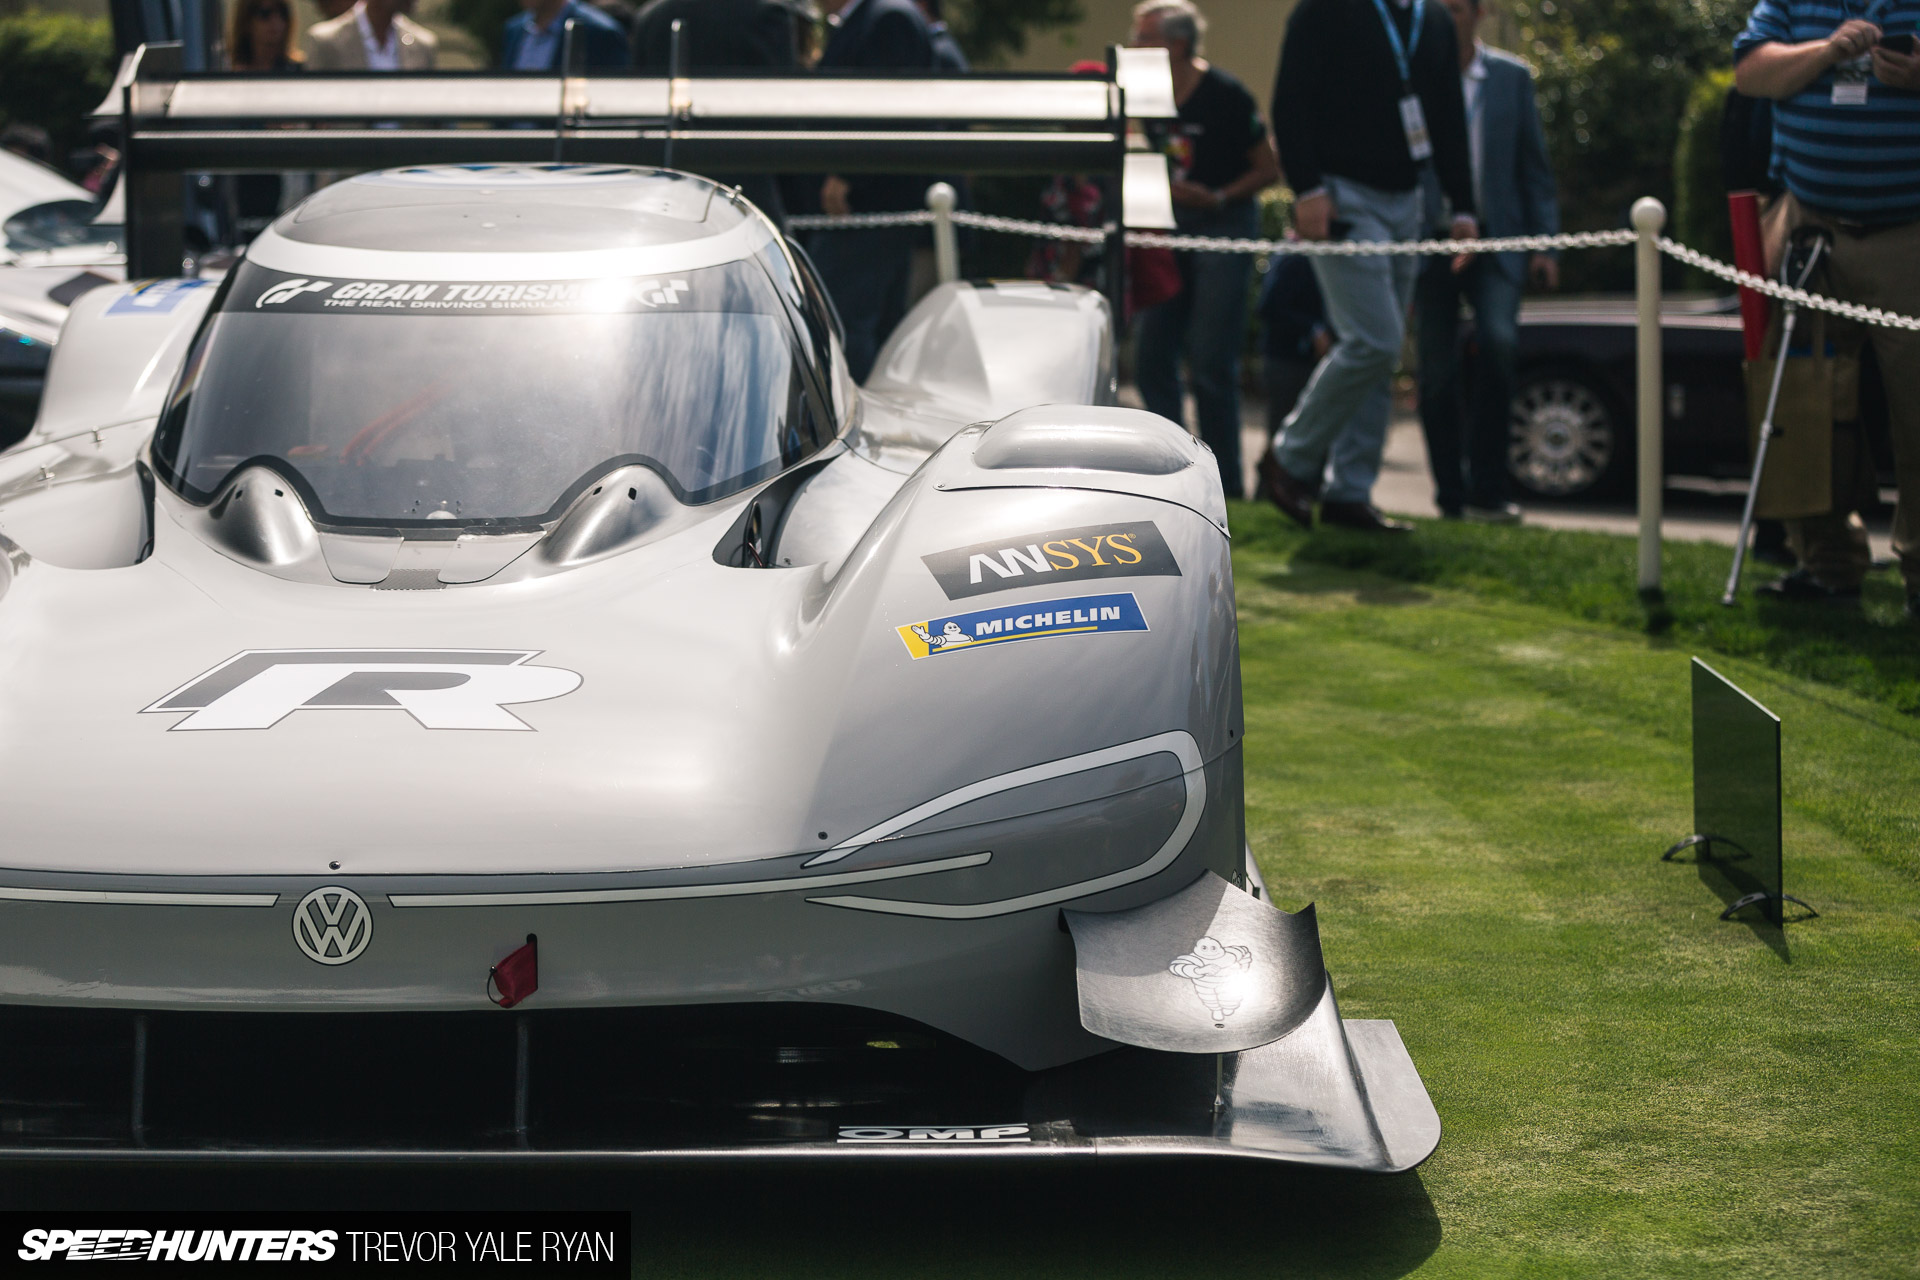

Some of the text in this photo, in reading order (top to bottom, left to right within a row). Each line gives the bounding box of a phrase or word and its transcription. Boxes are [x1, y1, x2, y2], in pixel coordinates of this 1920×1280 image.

[322, 299, 598, 310] THE REAL DRIVING SIMULAT
[331, 281, 598, 302] GRAN TURISM
[969, 532, 1143, 585] ANSYS
[975, 605, 1121, 636] MICHELIN
[137, 648, 584, 732] R
[838, 1125, 1030, 1140] OMP
